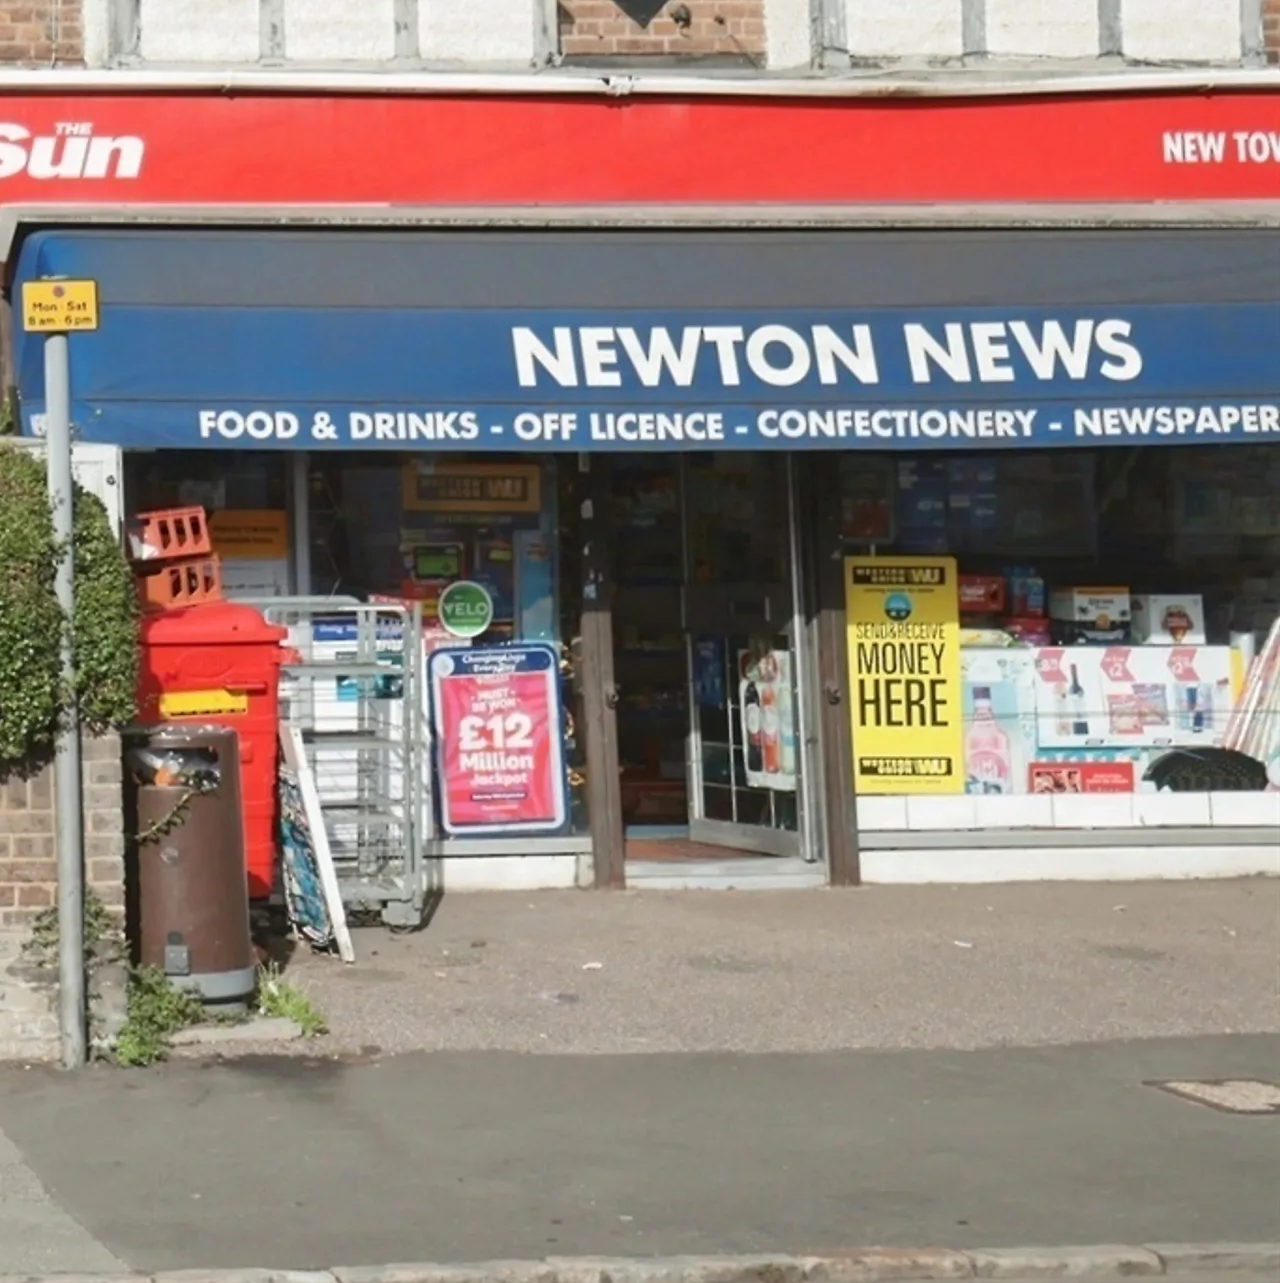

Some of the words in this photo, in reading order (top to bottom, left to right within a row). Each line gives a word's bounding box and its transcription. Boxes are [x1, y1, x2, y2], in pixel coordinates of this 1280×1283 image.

[54, 122, 93, 136] THE
[1162, 131, 1226, 163] NEW
[32, 301, 58, 312] Mon
[66, 300, 87, 312] Sat
[74, 316, 93, 327] pm
[511, 324, 879, 387] NEWTON
[903, 318, 1143, 383] NEWS
[198, 410, 300, 440] FOOD
[310, 412, 338, 440] &
[349, 412, 479, 440] DRINKS
[513, 412, 577, 441] OFF
[589, 412, 724, 441] LICENCE
[757, 409, 1038, 439] CONFECTIONERY
[1074, 404, 1280, 437] NEWSPAPER
[910, 568, 941, 583] WU
[444, 602, 489, 616] VELO
[857, 642, 946, 675] MONEY
[858, 679, 949, 727] HERE
[459, 712, 533, 751] £12
[459, 750, 534, 773] Million
[914, 759, 949, 775] WU
[469, 772, 528, 787] Jackpot
